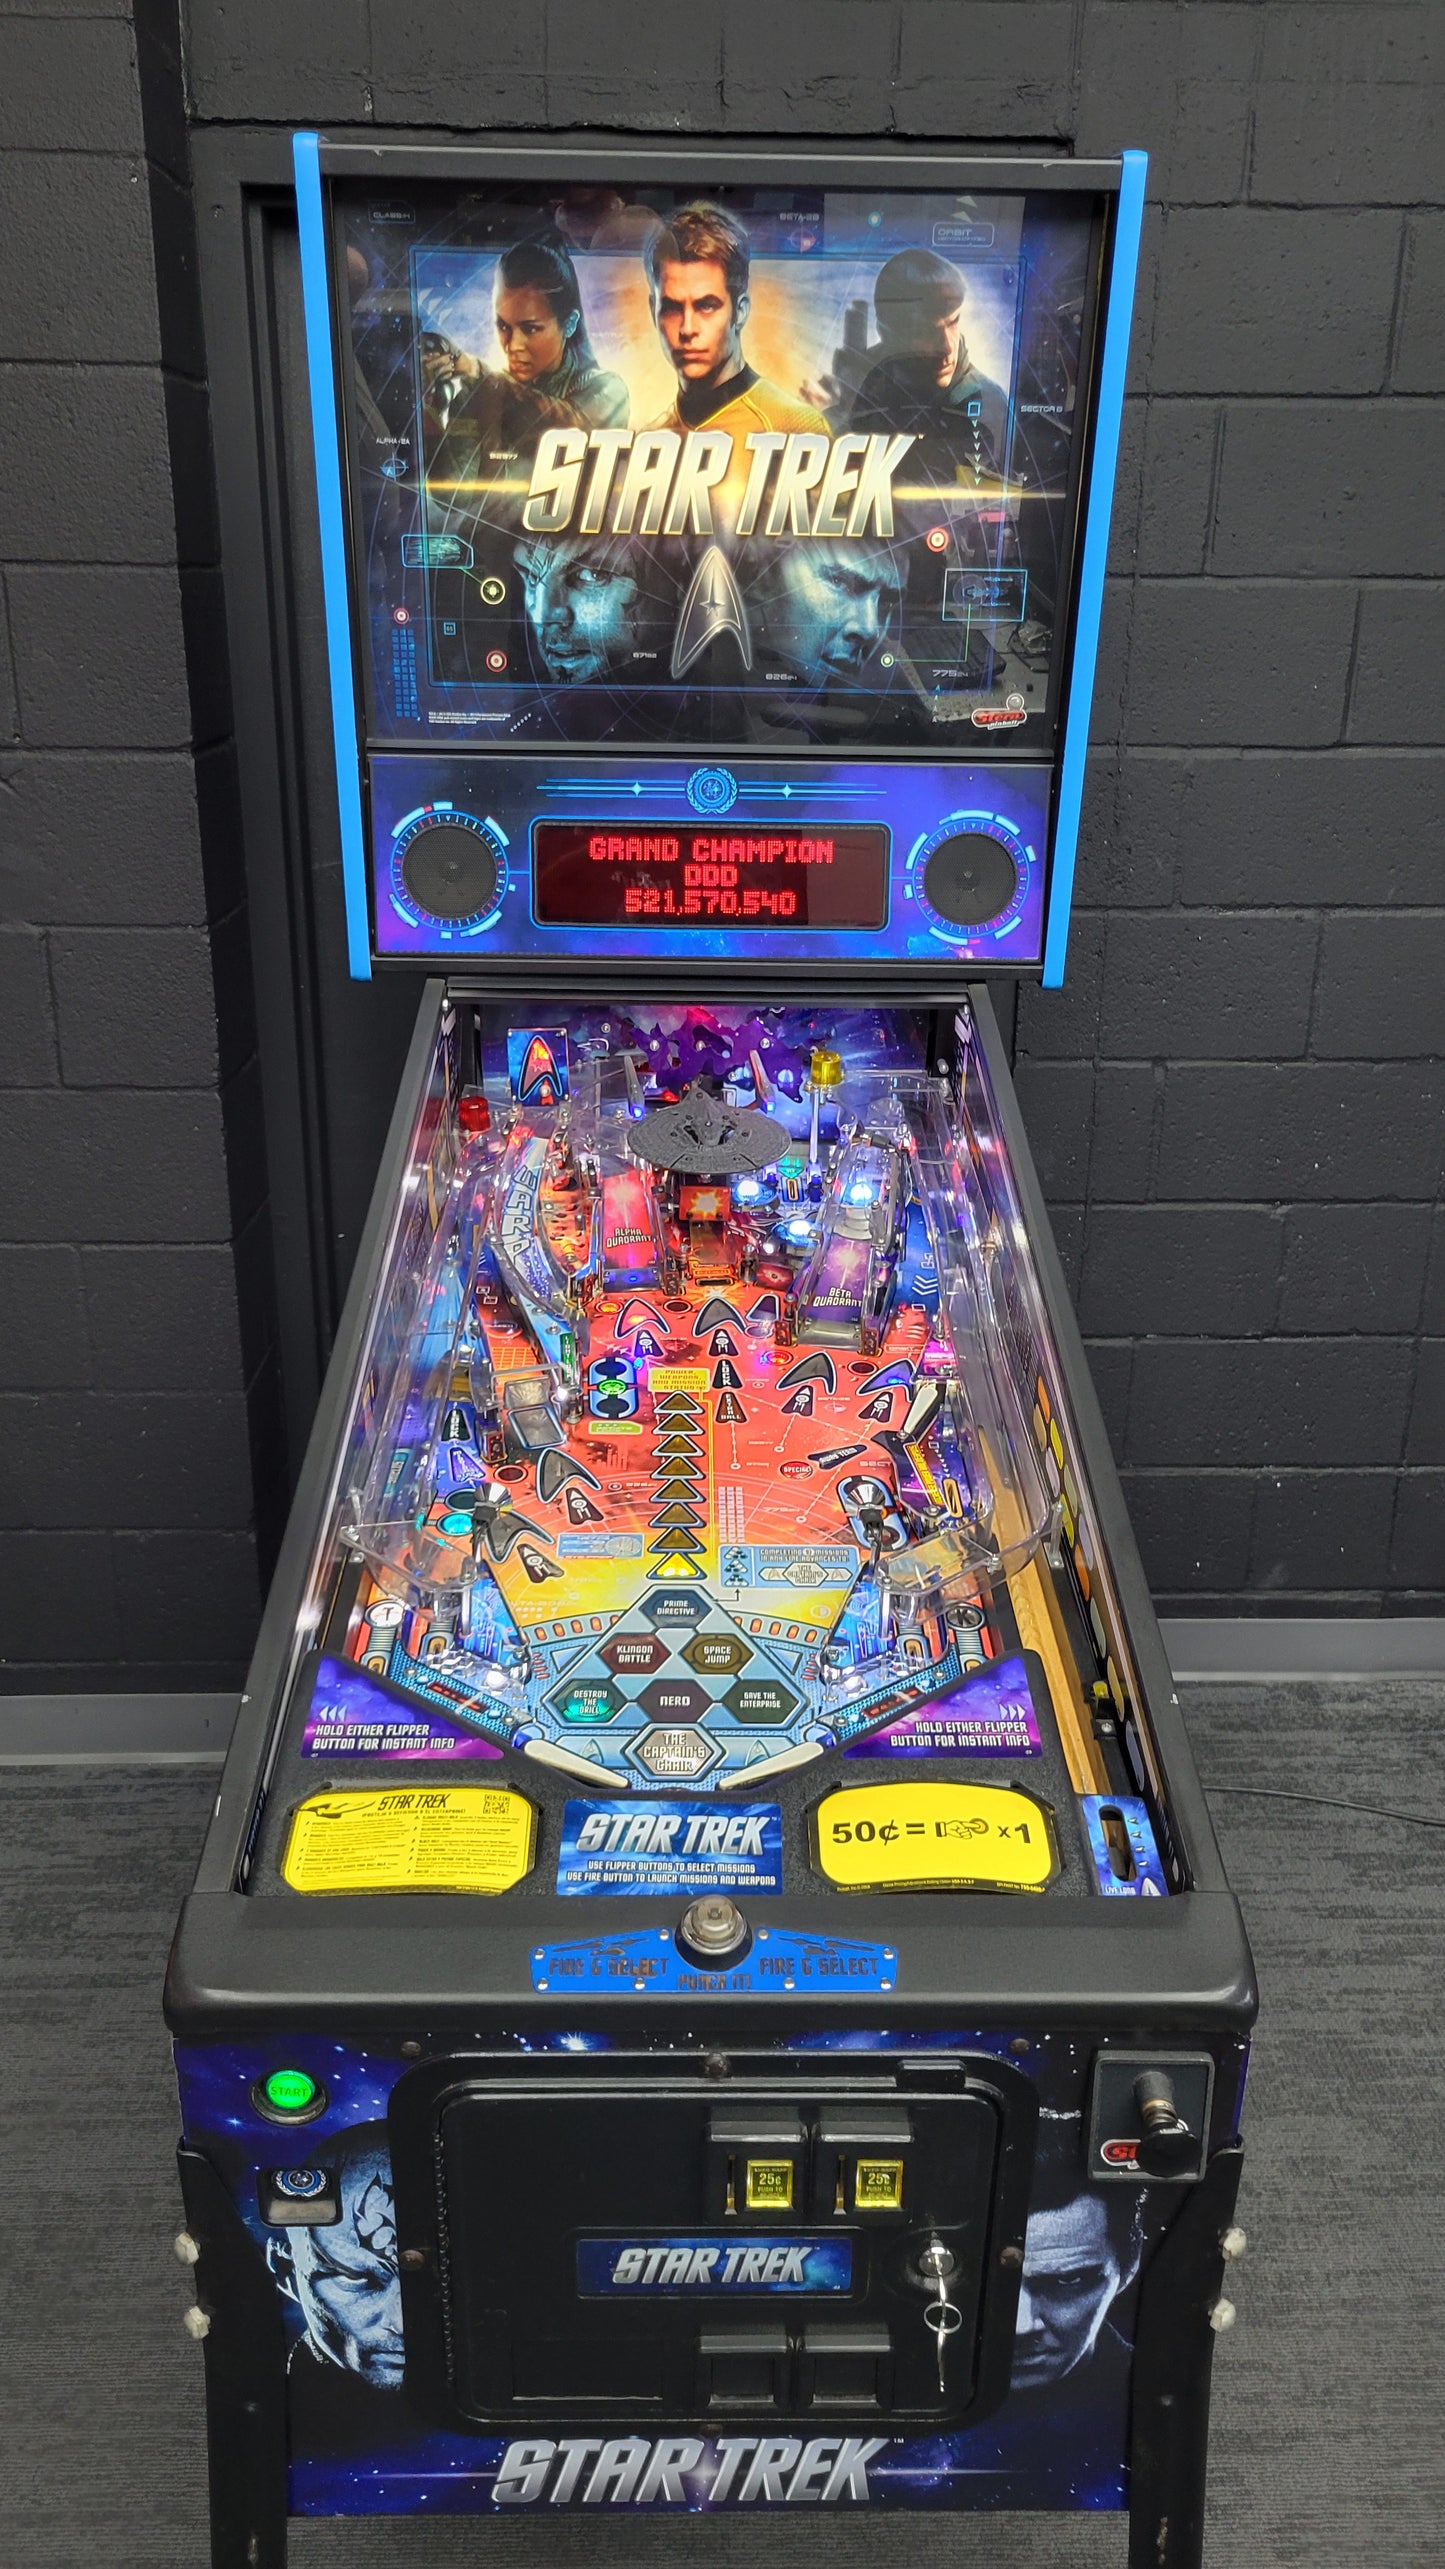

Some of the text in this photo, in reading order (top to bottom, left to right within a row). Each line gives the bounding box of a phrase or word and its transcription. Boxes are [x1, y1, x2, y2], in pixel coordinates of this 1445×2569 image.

[1020, 405, 1055, 413] SECTOR
[522, 428, 735, 535] STAR
[735, 432, 917, 539] TREK
[589, 837, 834, 864] GRAND CHAMPION
[624, 888, 797, 916] 521,570,540
[501, 1163, 538, 1279] WARP
[614, 1227, 642, 1237] ALPHA
[606, 1234, 652, 1248] QUADRANT
[829, 1287, 852, 1298] BETA
[812, 1296, 863, 1307] QUADRANT
[721, 1360, 732, 1386] LOCK
[783, 1463, 813, 1473] SPECIAL
[663, 1600, 689, 1608] PRIME
[383, 1607, 394, 1621] T
[656, 1607, 695, 1616] DIRECTIVE
[957, 1608, 971, 1626] K
[616, 1645, 654, 1655] KLINGON
[703, 1645, 732, 1655] SPACE
[618, 1654, 651, 1664] BATTLE
[704, 1655, 731, 1664] JUMP
[573, 1689, 608, 1699] DESTROY
[743, 1692, 776, 1700] SAVE THE
[583, 1698, 597, 1706] THE
[659, 1695, 691, 1706] NERO
[739, 1700, 781, 1709] ENTERPRISE
[579, 1705, 600, 1715] DRILL
[315, 1724, 429, 1736] HOLD EITHER FLIPPER
[915, 1721, 1028, 1733] HOLD EITHER FLIPPER
[312, 1737, 455, 1749] BUTTON FOR INSTANT INFO
[663, 1733, 686, 1746] THE
[890, 1735, 1030, 1747] BUTTON FOR INSTANT INFO
[643, 1746, 705, 1758] CAPTAIN'S
[656, 1758, 693, 1772] CHAIR
[377, 1793, 451, 1811] STAR TREK
[576, 1813, 683, 1854] STAR
[682, 1815, 770, 1856] TREK
[832, 1819, 900, 1846] 50¢
[588, 1860, 756, 1874] USE FLIPPER BUTTONS TO SELECT MISSIONS
[567, 1871, 776, 1887] USE FIRE BUTTON TO LAUNCH MISSIONS AND WEAPONS
[548, 1958, 584, 1976] FIRE
[608, 1958, 670, 1977] SELECT
[759, 1958, 798, 1976] FIRE
[818, 1958, 878, 1976] SELECT
[678, 1974, 727, 1991] PUNCH
[271, 2085, 309, 2098] START
[612, 2247, 721, 2285] STAR
[720, 2246, 813, 2284] TREK
[491, 2438, 705, 2503] STAR
[708, 2437, 893, 2501] TREK
